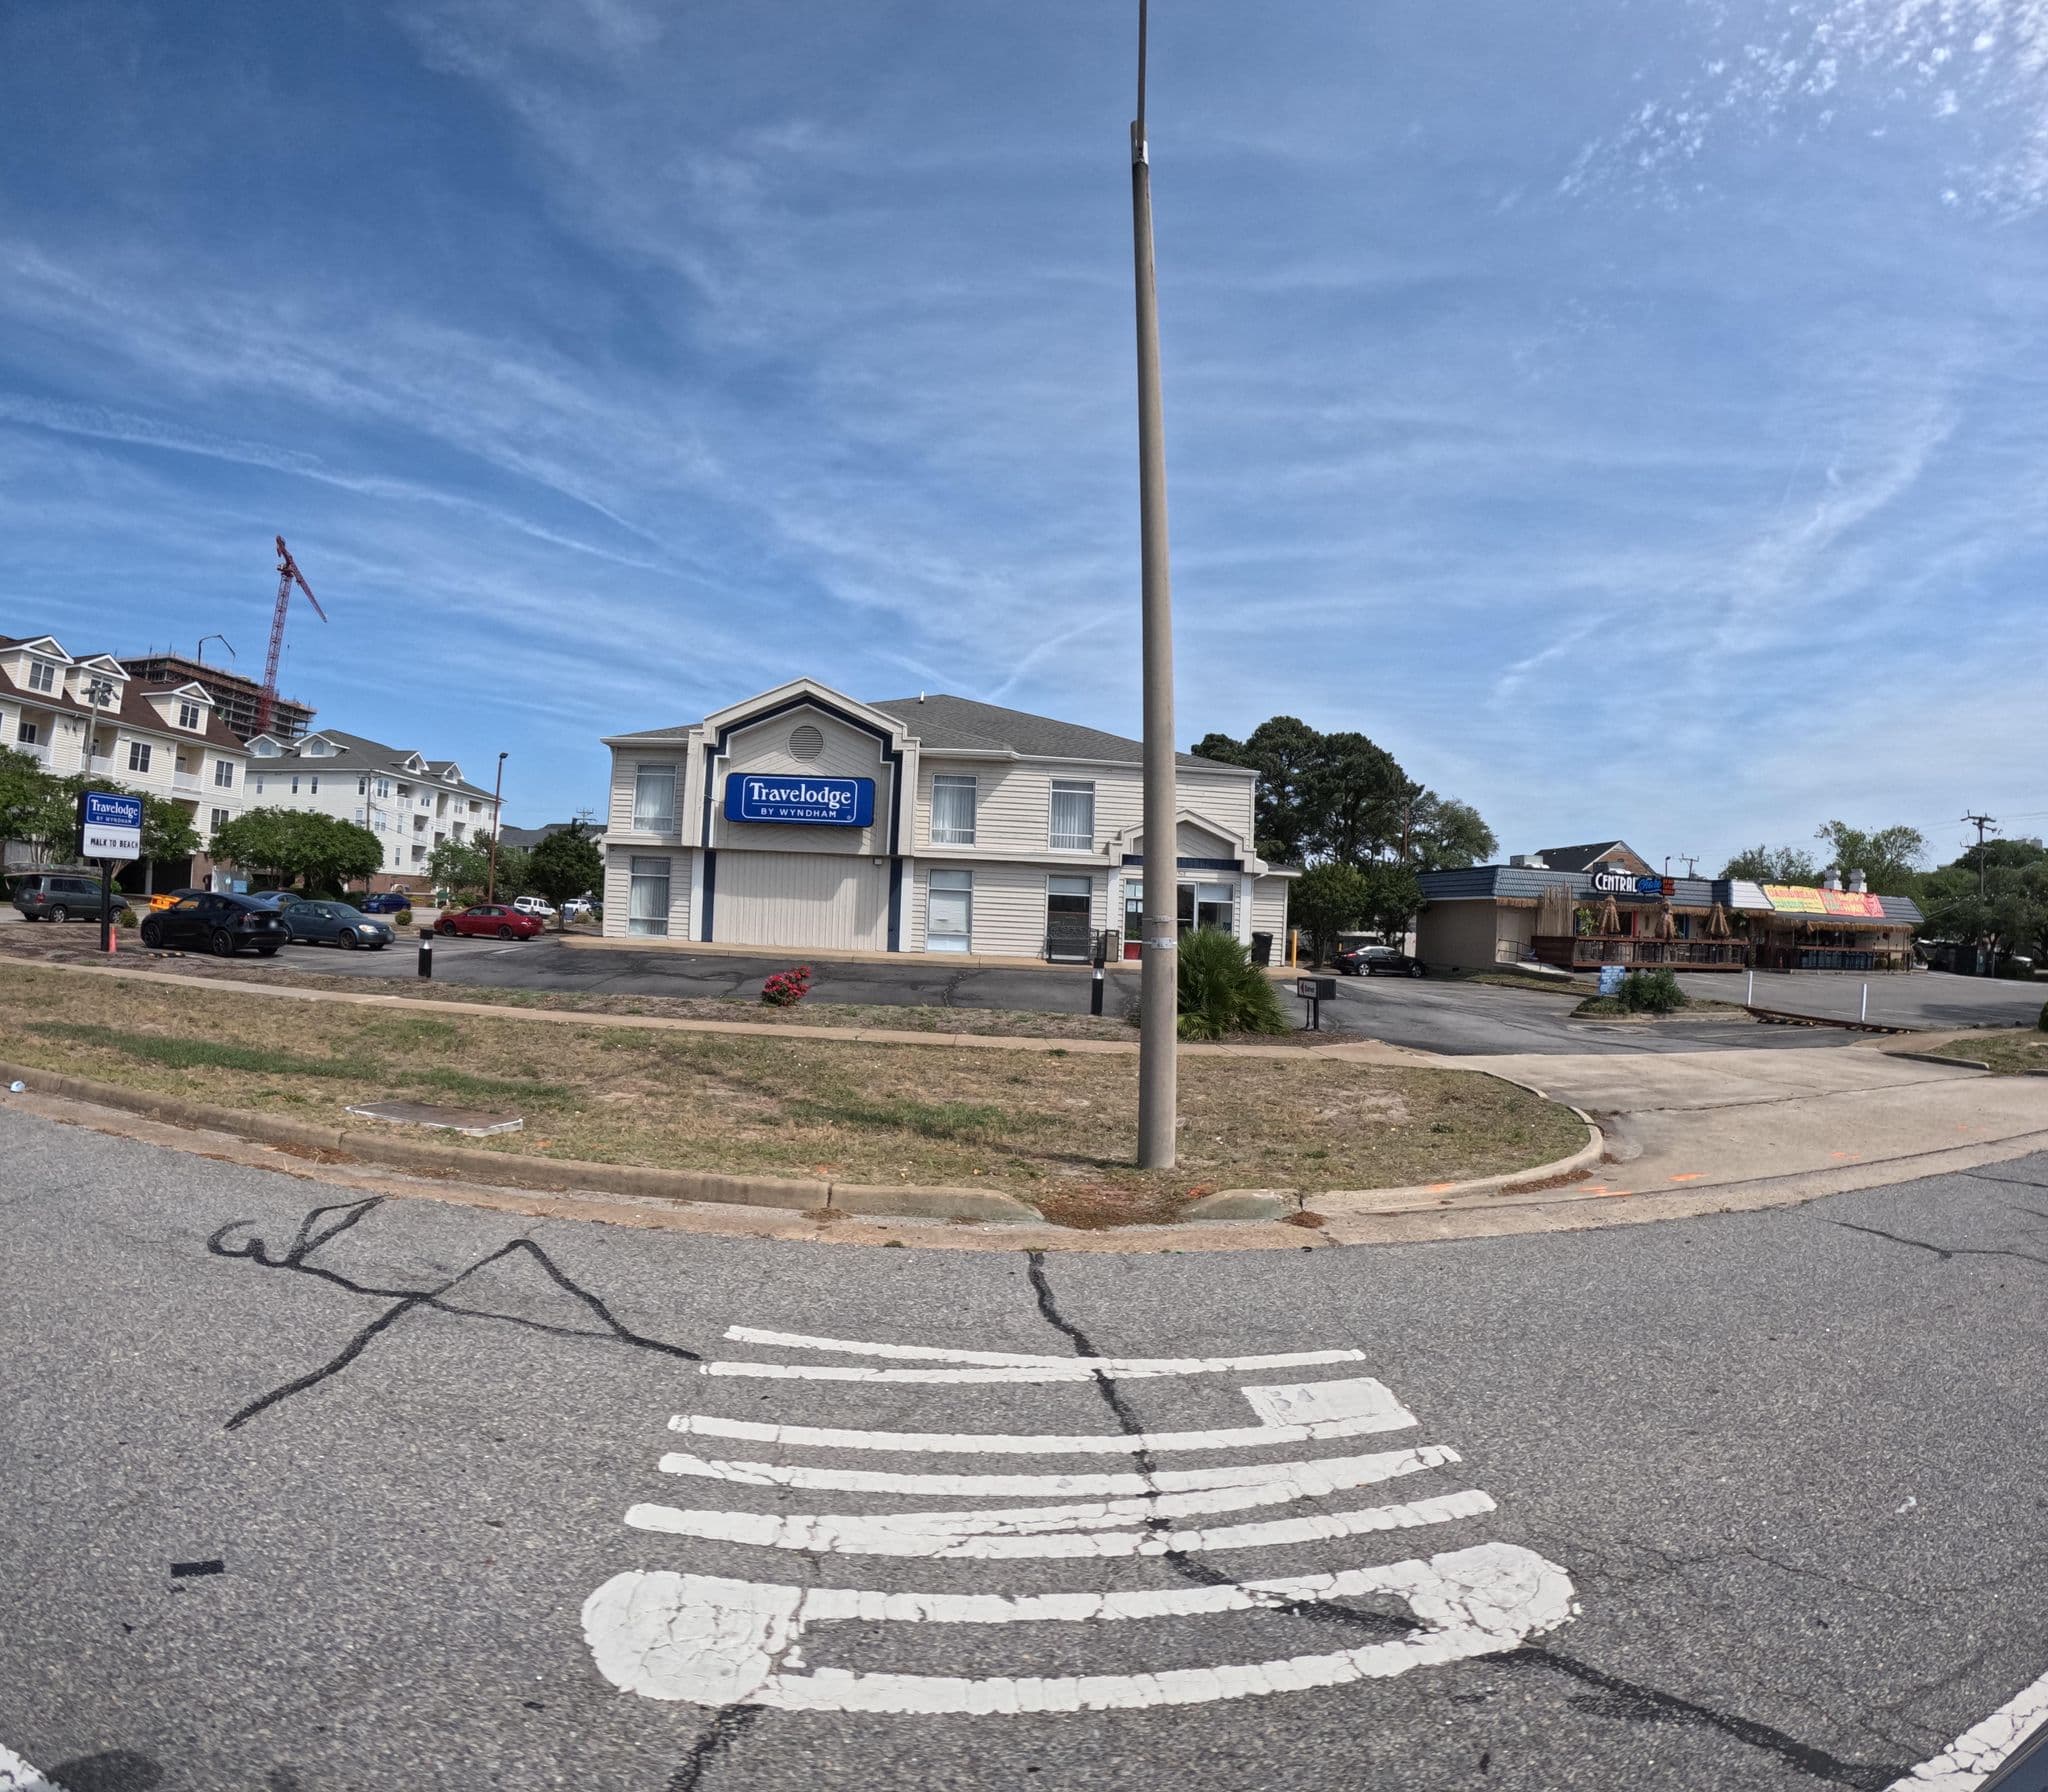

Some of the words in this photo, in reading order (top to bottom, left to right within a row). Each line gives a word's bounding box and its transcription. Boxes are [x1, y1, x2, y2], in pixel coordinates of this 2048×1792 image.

[749, 782, 851, 809] Travelodge
[90, 799, 138, 818] Travelodge
[760, 807, 775, 816] BY
[779, 808, 837, 818] WYNDHAM
[109, 839, 117, 847] TO
[119, 840, 138, 848] BEACH
